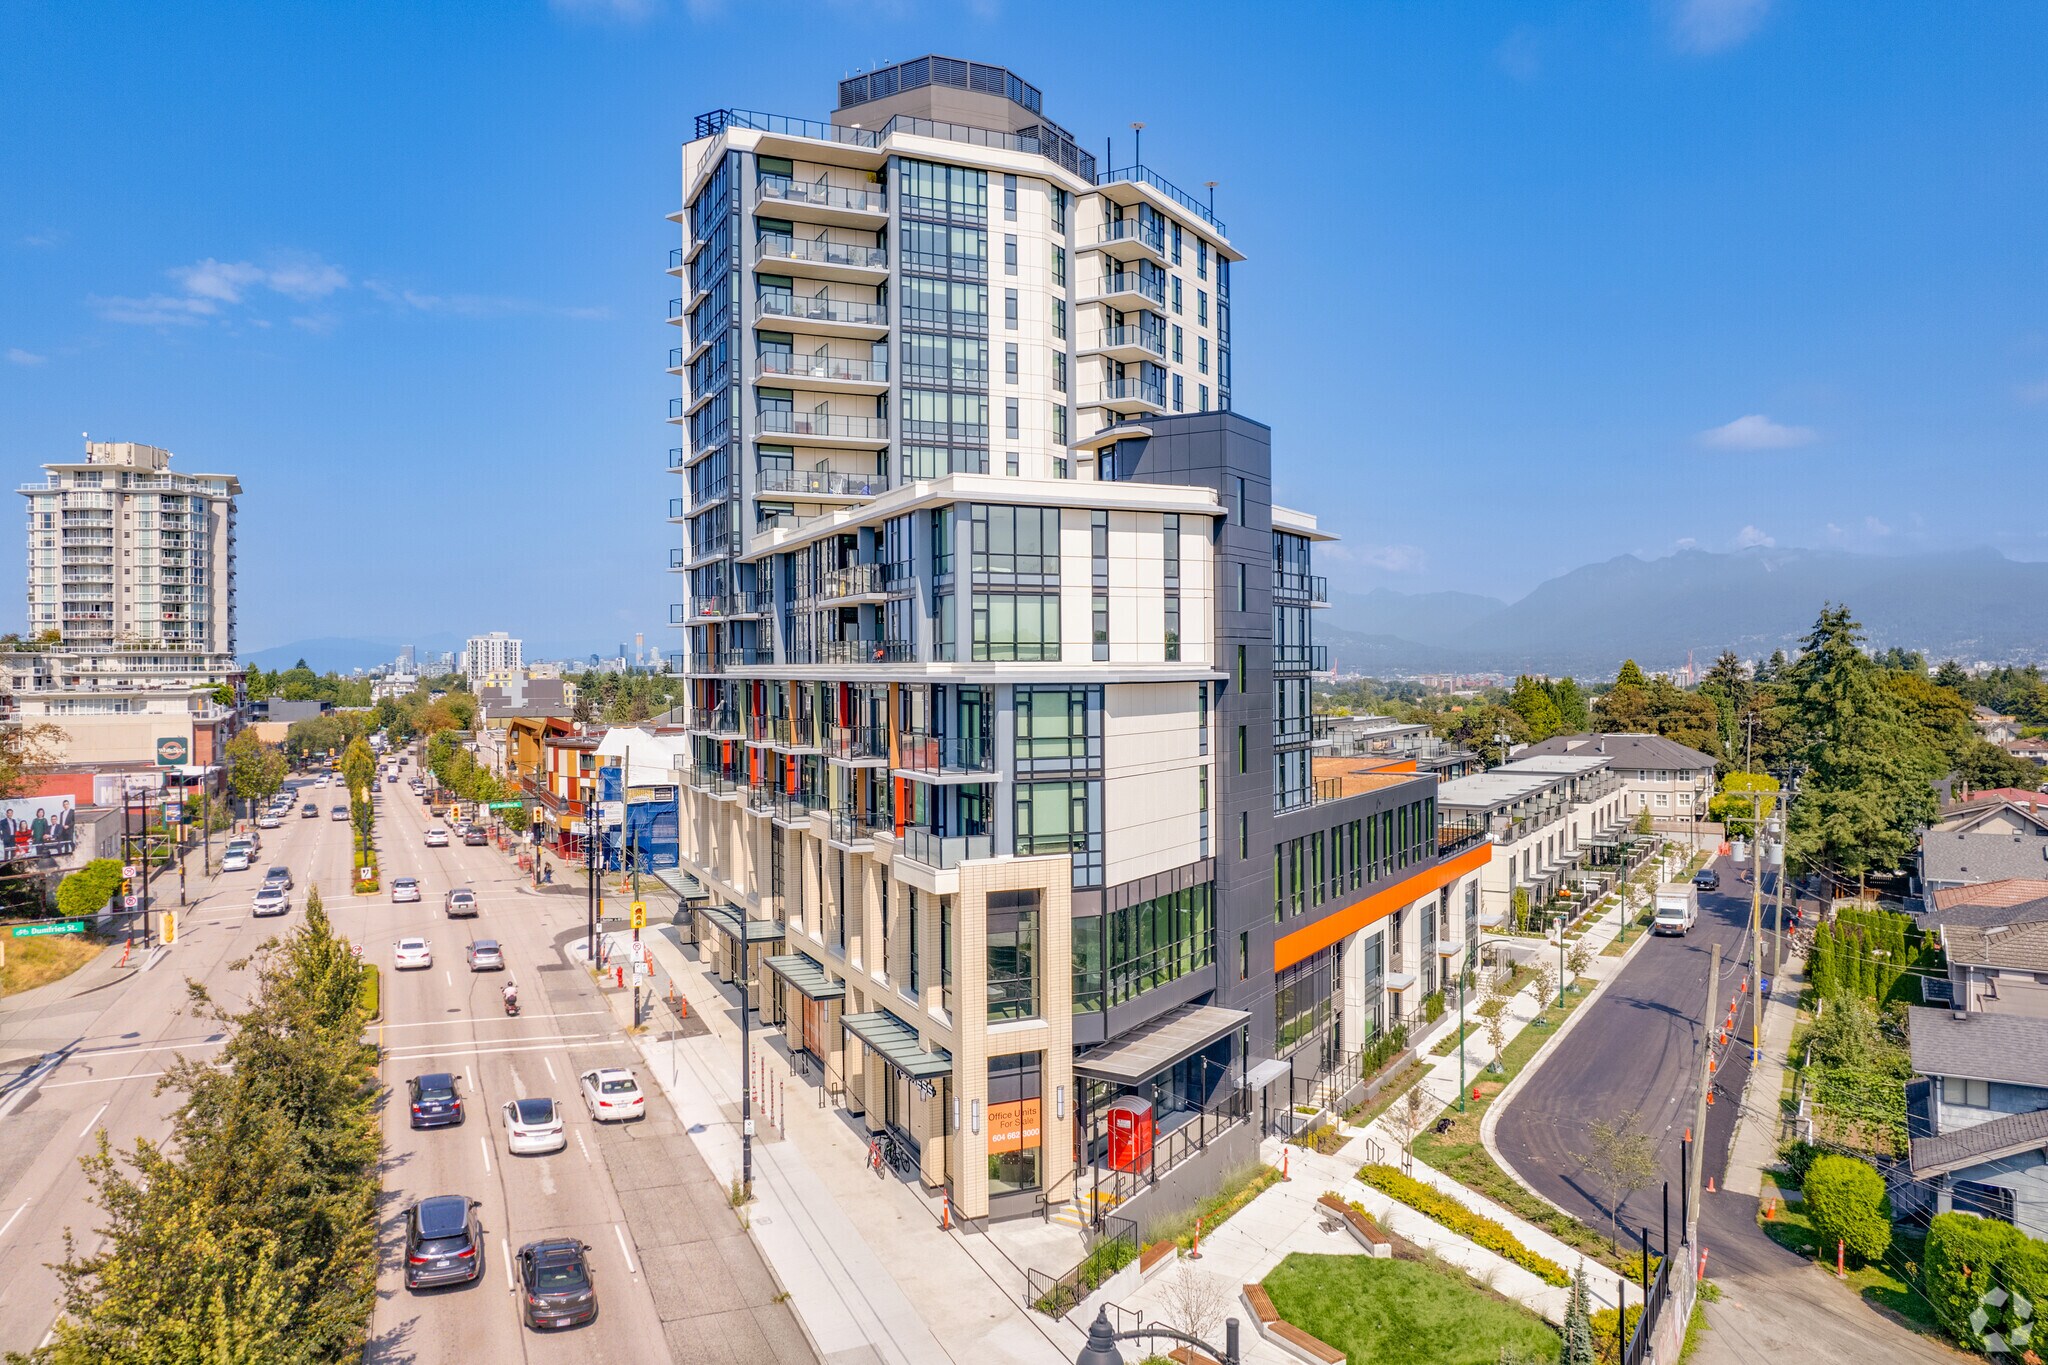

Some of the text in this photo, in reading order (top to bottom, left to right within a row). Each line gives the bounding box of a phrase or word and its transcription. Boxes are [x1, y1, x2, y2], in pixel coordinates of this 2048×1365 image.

[31, 924, 78, 935] Dumfries St.
[988, 1108, 1037, 1121] Office Units
[1000, 1118, 1034, 1129] For Sale
[992, 1134, 1006, 1142] 604
